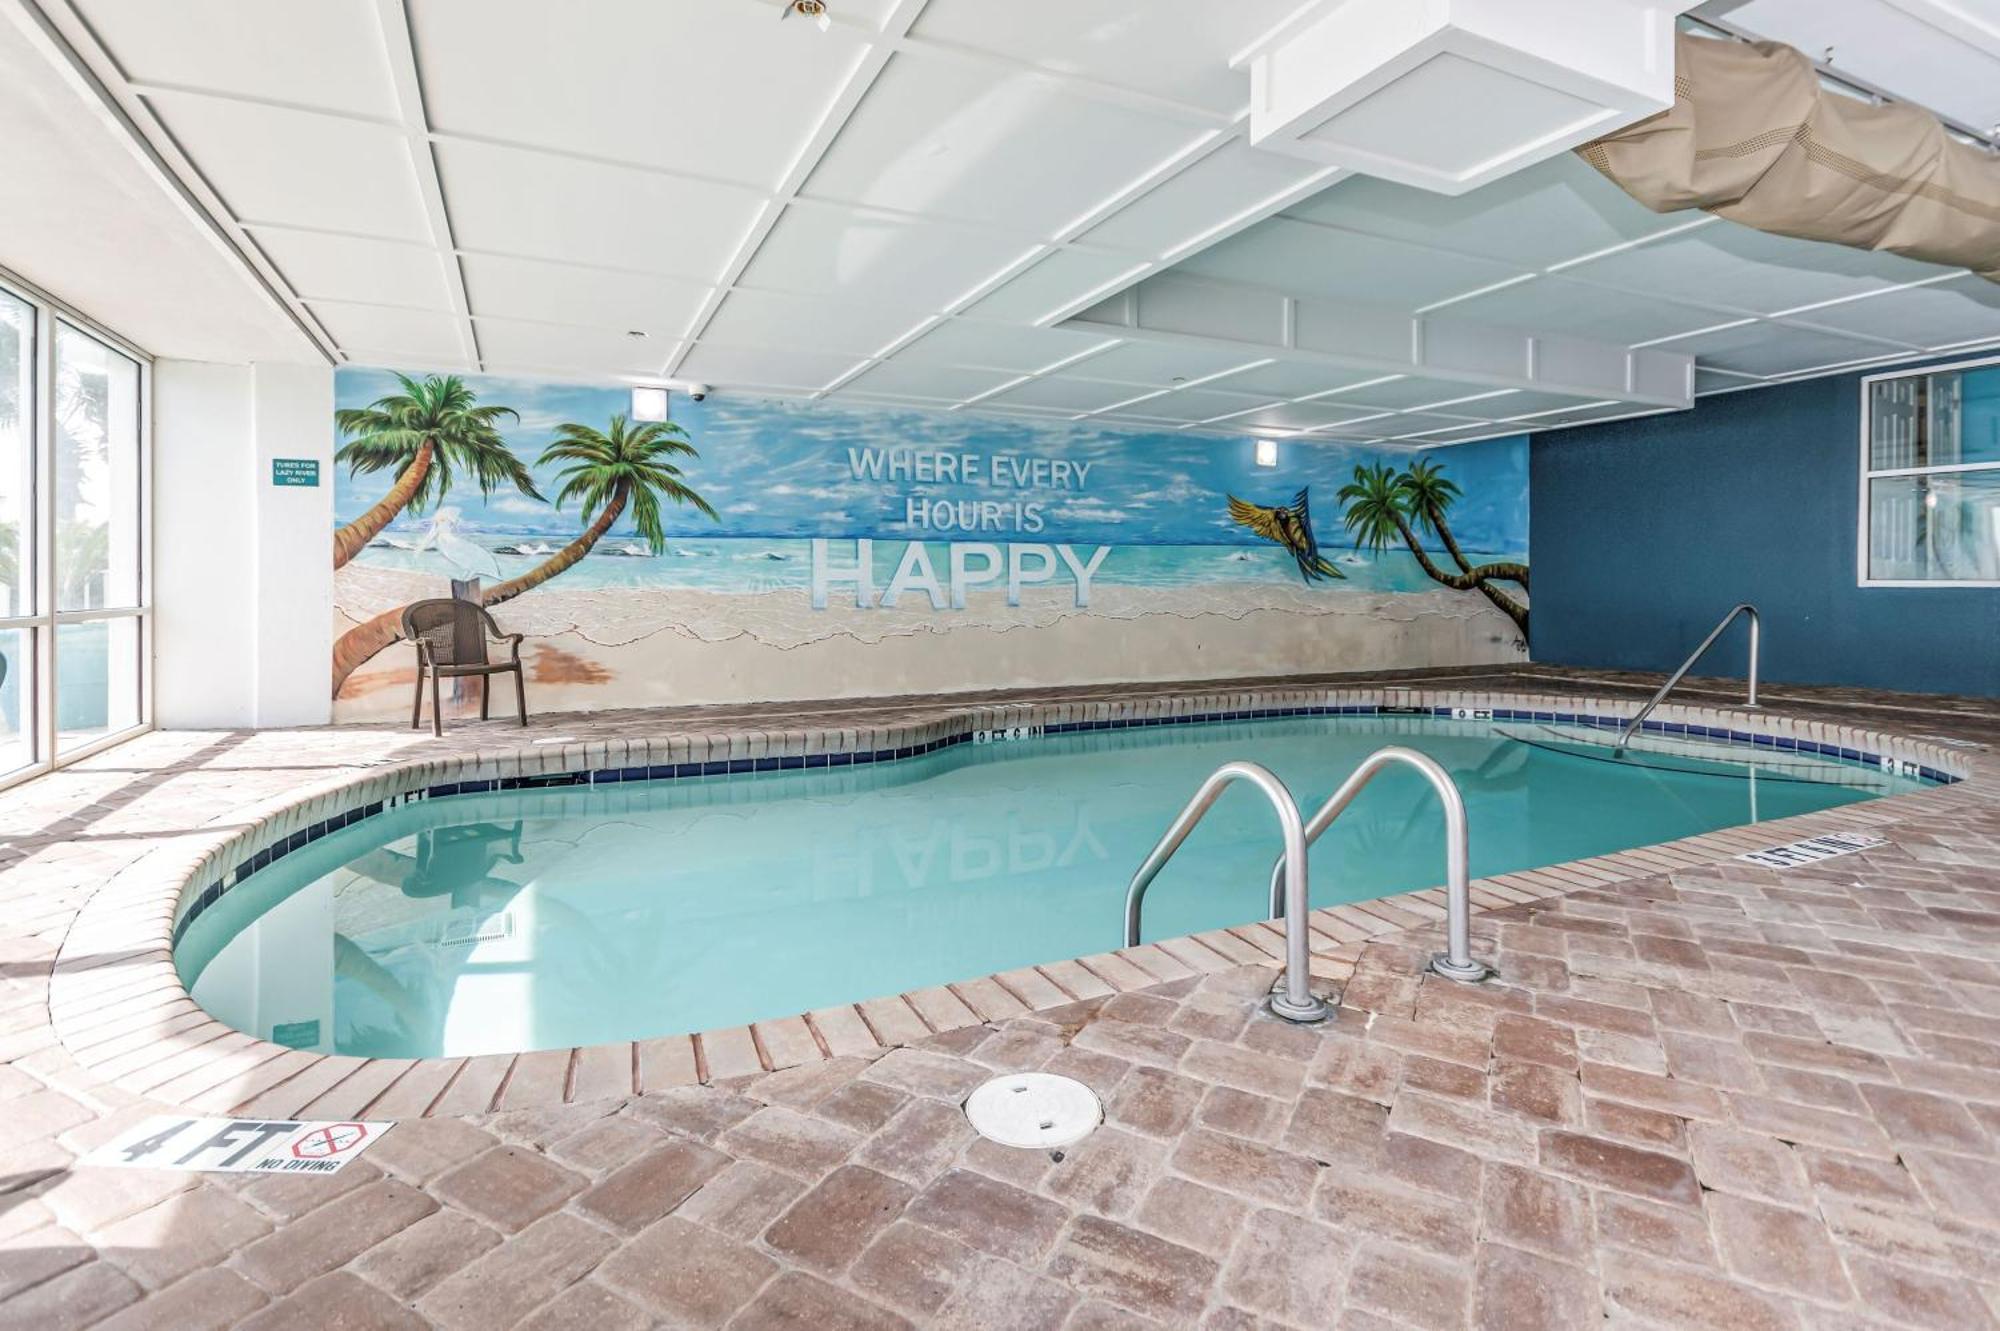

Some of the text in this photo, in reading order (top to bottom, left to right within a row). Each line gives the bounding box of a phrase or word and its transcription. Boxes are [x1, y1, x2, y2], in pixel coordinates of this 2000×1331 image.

[848, 447, 1091, 489] WHERE EVERY
[906, 498, 1045, 533] HOUR IS
[811, 538, 1111, 609] HAPPY
[120, 1119, 302, 1167] 4 FT
[257, 1158, 340, 1171] NO DIVING
